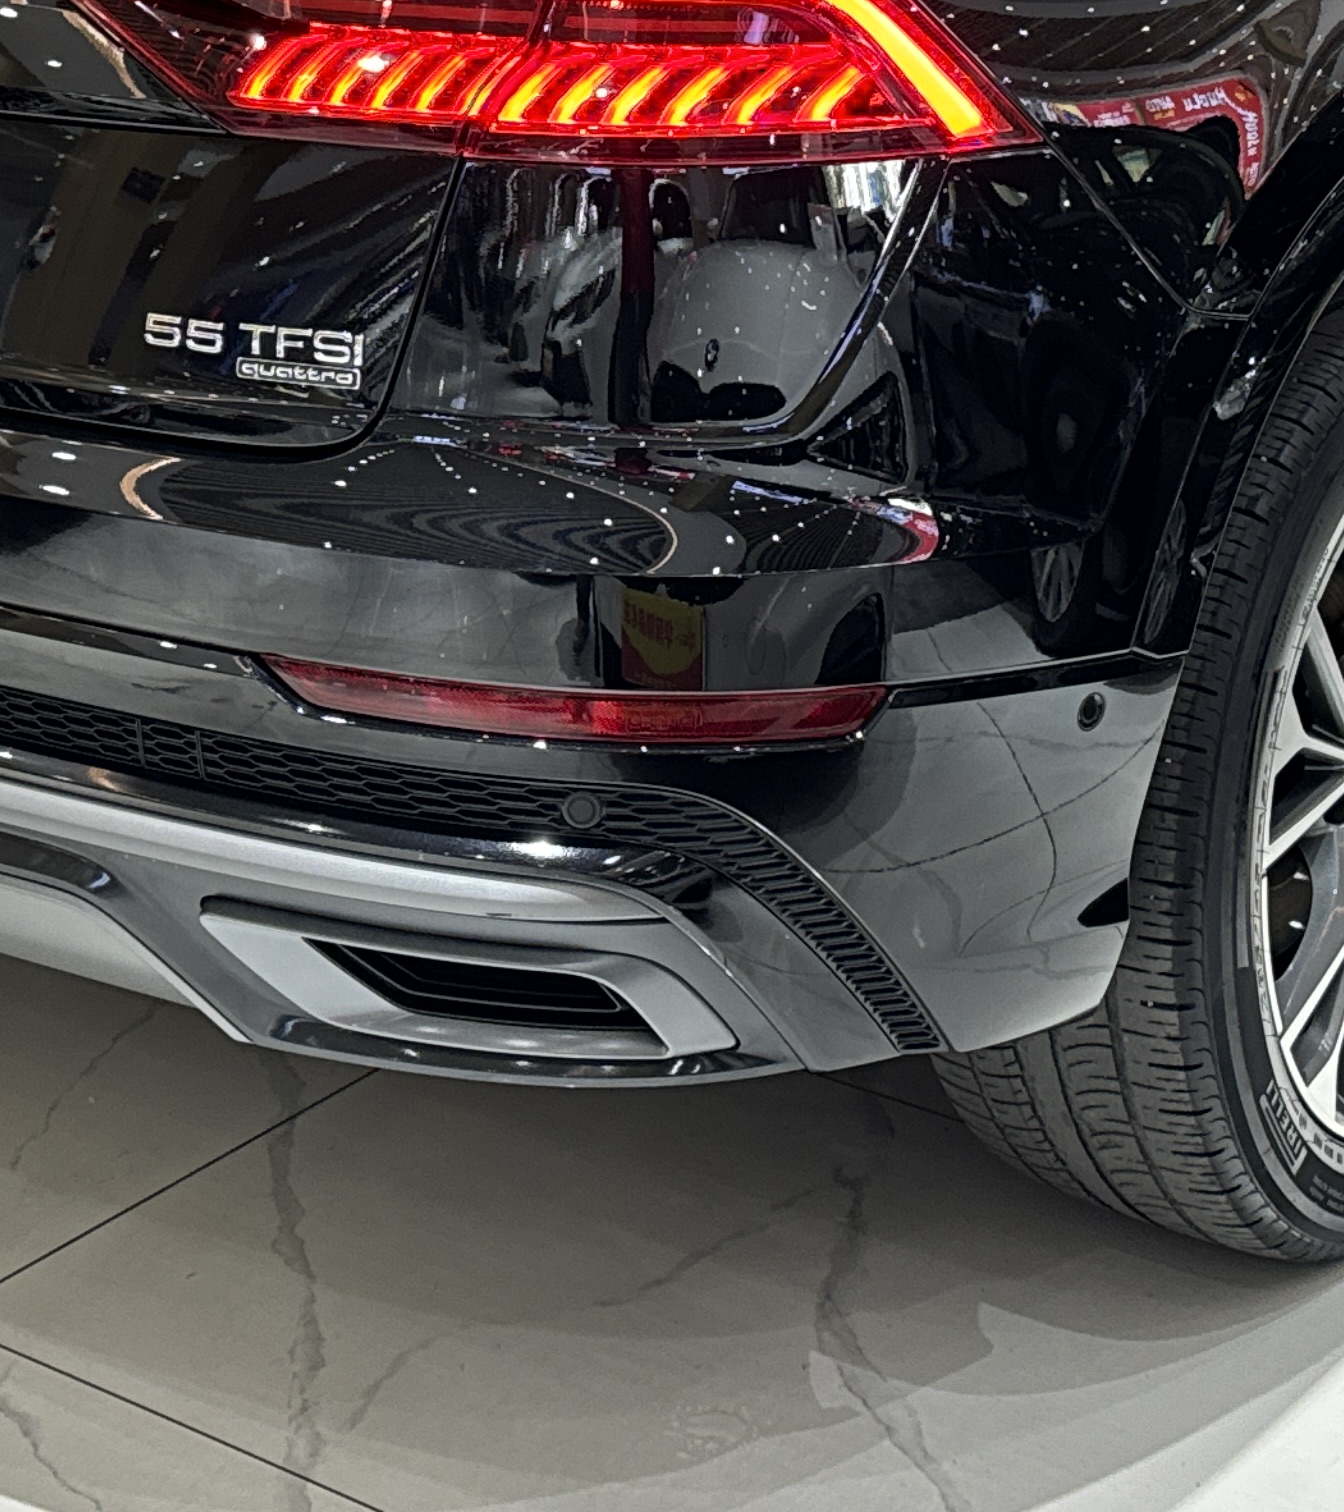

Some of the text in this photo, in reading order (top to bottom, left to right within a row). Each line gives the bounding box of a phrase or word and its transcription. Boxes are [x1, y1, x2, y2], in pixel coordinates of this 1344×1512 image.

[144, 312, 365, 367] 55 TFSI
[241, 362, 354, 385] quattro
